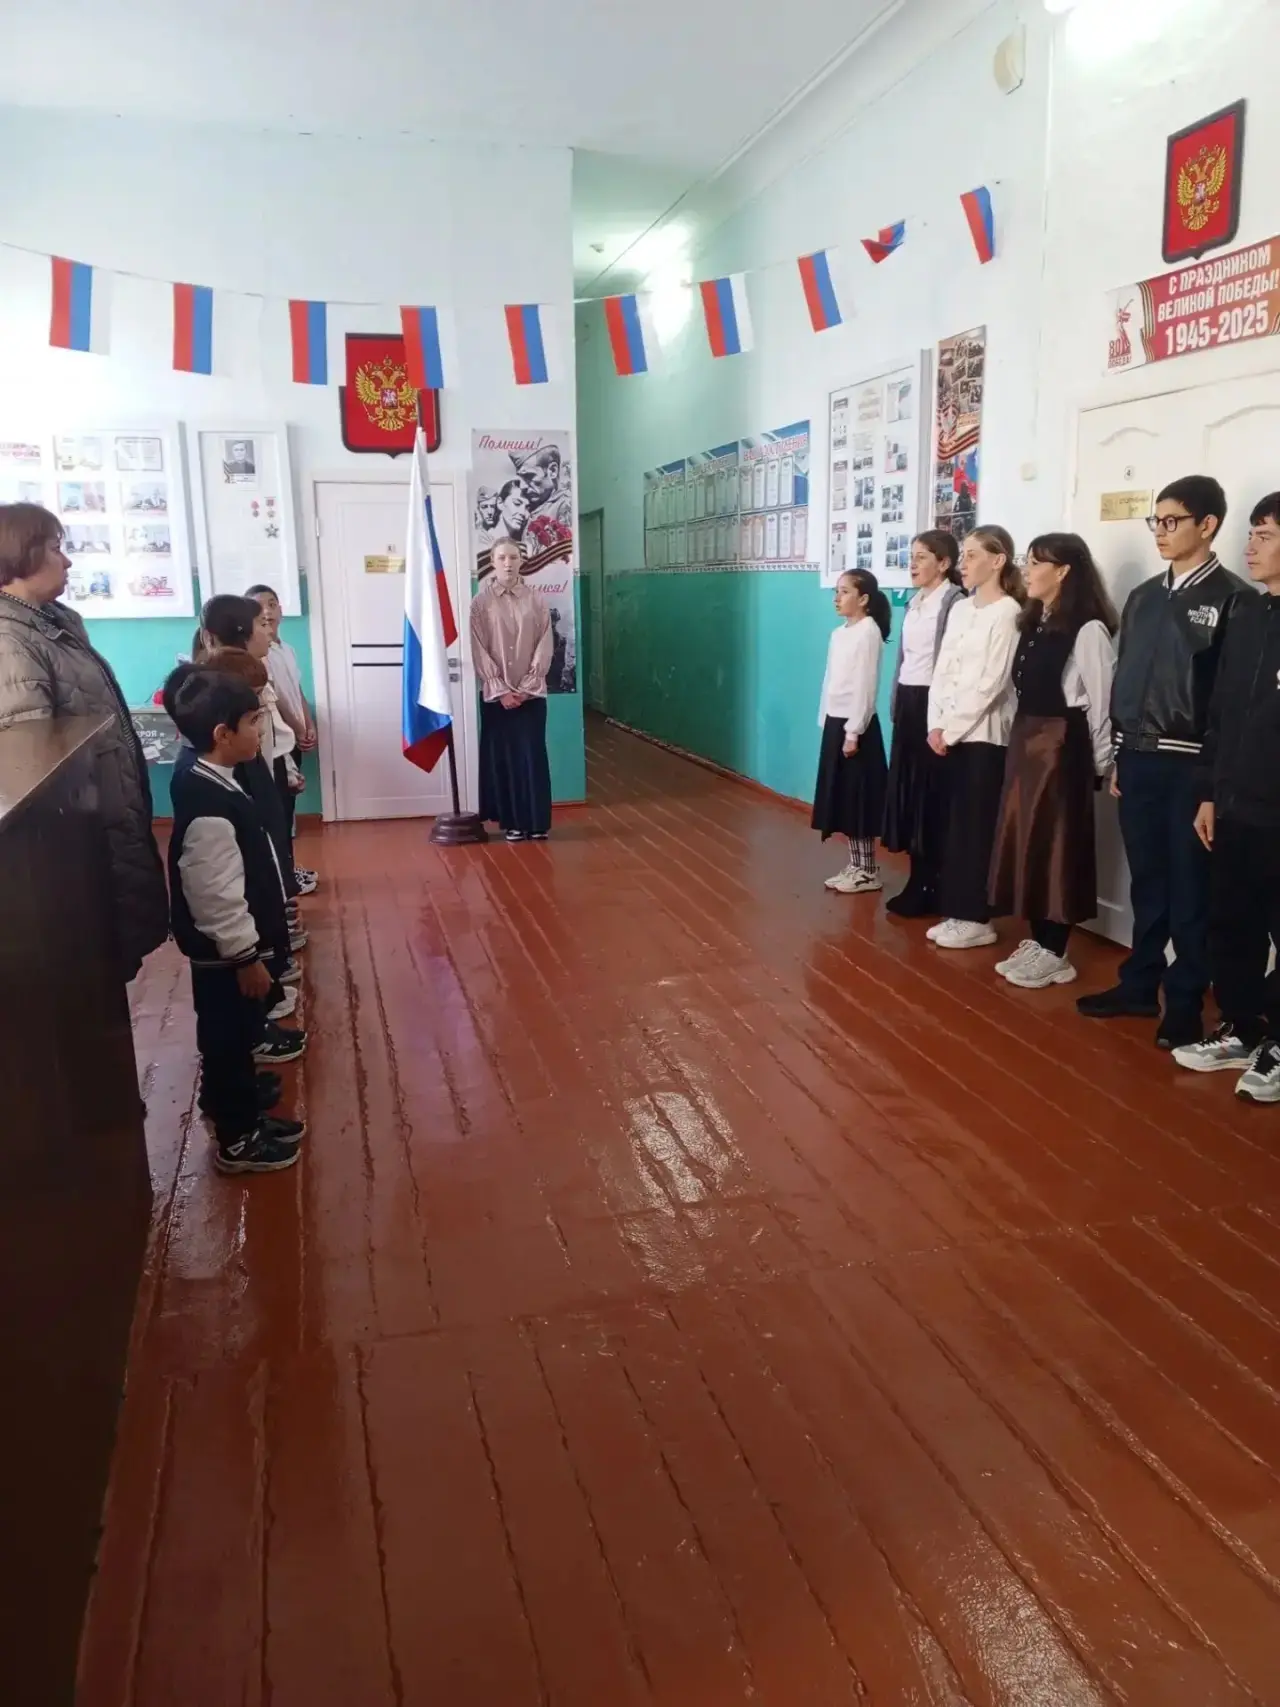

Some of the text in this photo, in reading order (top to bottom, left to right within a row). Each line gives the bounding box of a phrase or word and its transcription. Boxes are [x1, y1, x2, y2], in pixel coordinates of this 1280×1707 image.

[1157, 268, 1280, 323] ВЕЛИКОЙ ПОБЕДЫ!
[1168, 244, 1272, 296] С ПРАЗДНИКОМ
[1165, 300, 1269, 355] 1945-2025
[478, 434, 543, 450] Помним!
